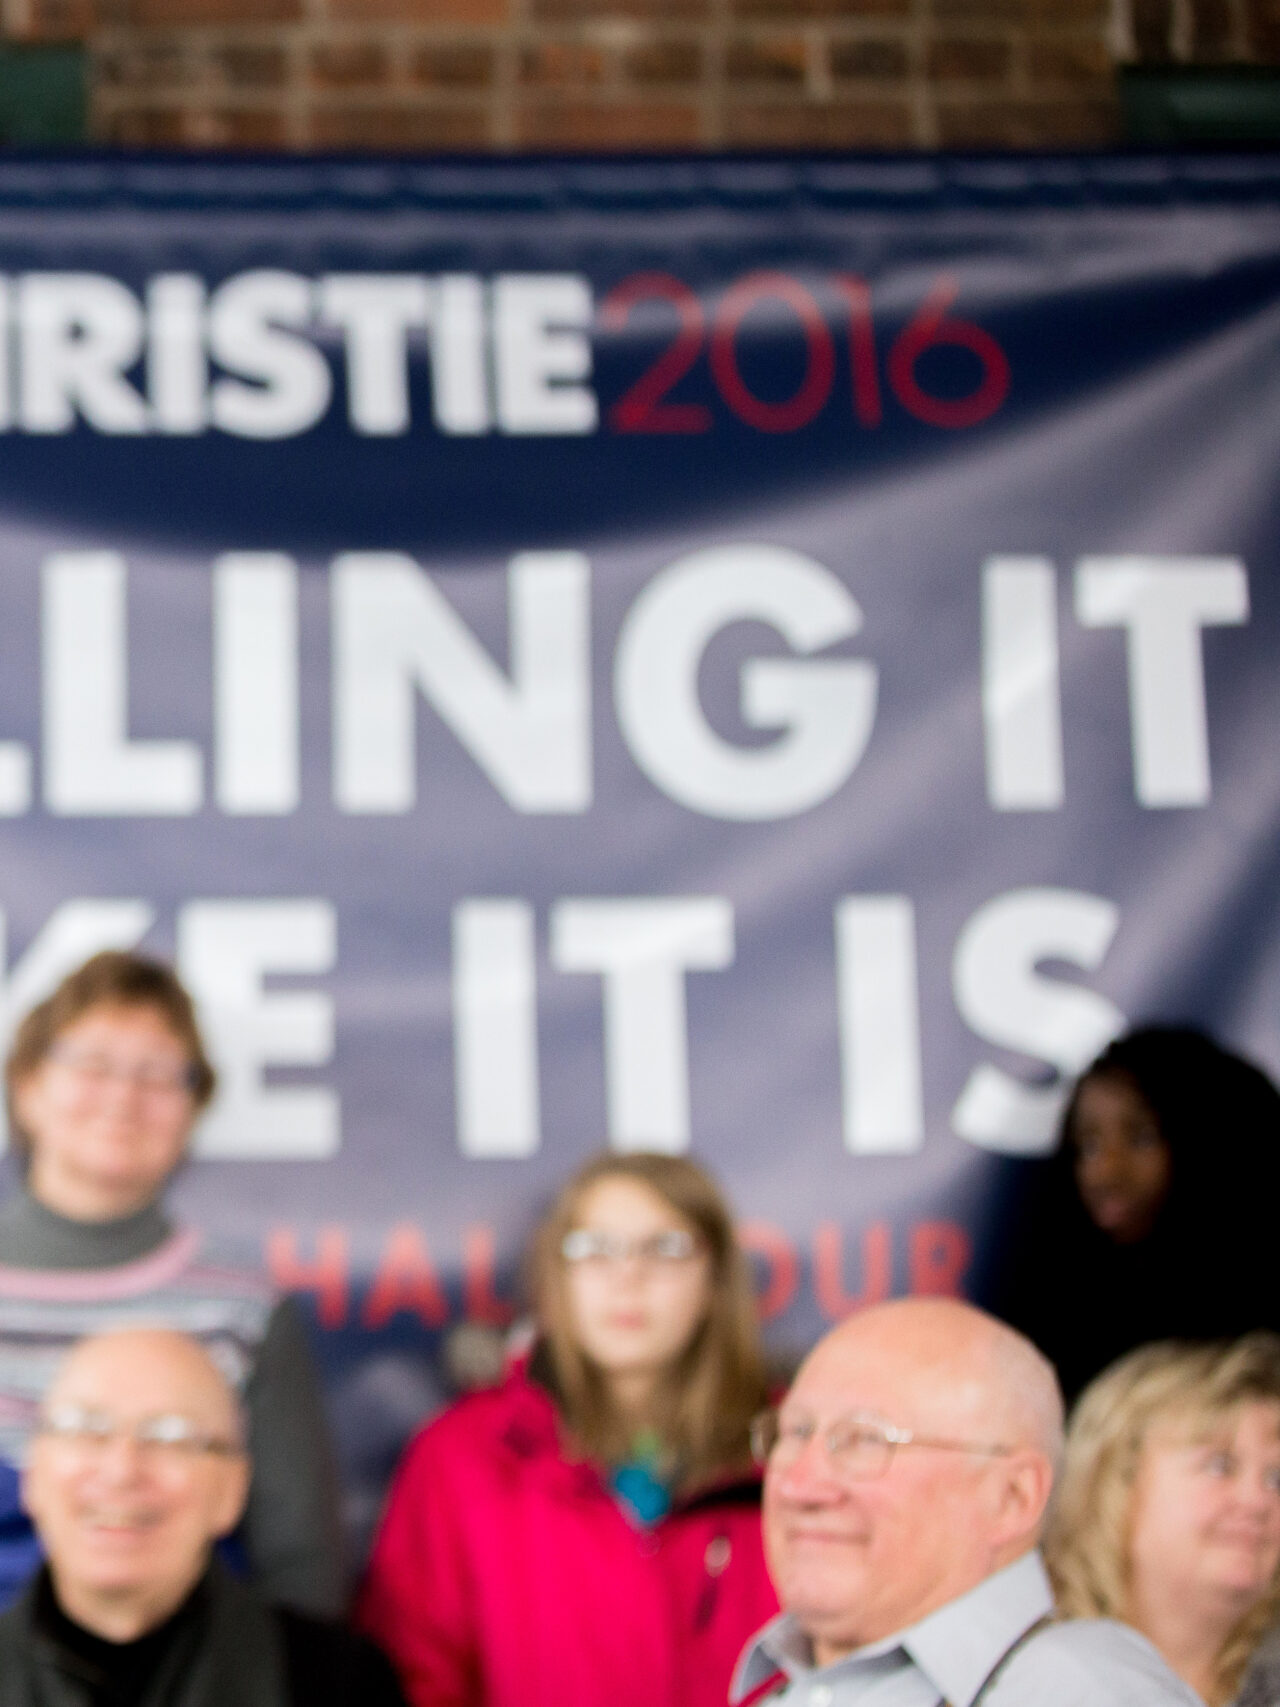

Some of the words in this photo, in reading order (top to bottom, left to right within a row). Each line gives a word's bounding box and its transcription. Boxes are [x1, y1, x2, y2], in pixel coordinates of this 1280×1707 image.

[599, 270, 1010, 435] 2016
[982, 554, 1249, 811] IT
[452, 896, 735, 1158] IT
[833, 886, 1125, 1157] IS
[266, 1220, 518, 1331] HAL
[734, 1217, 971, 1322] OUR
